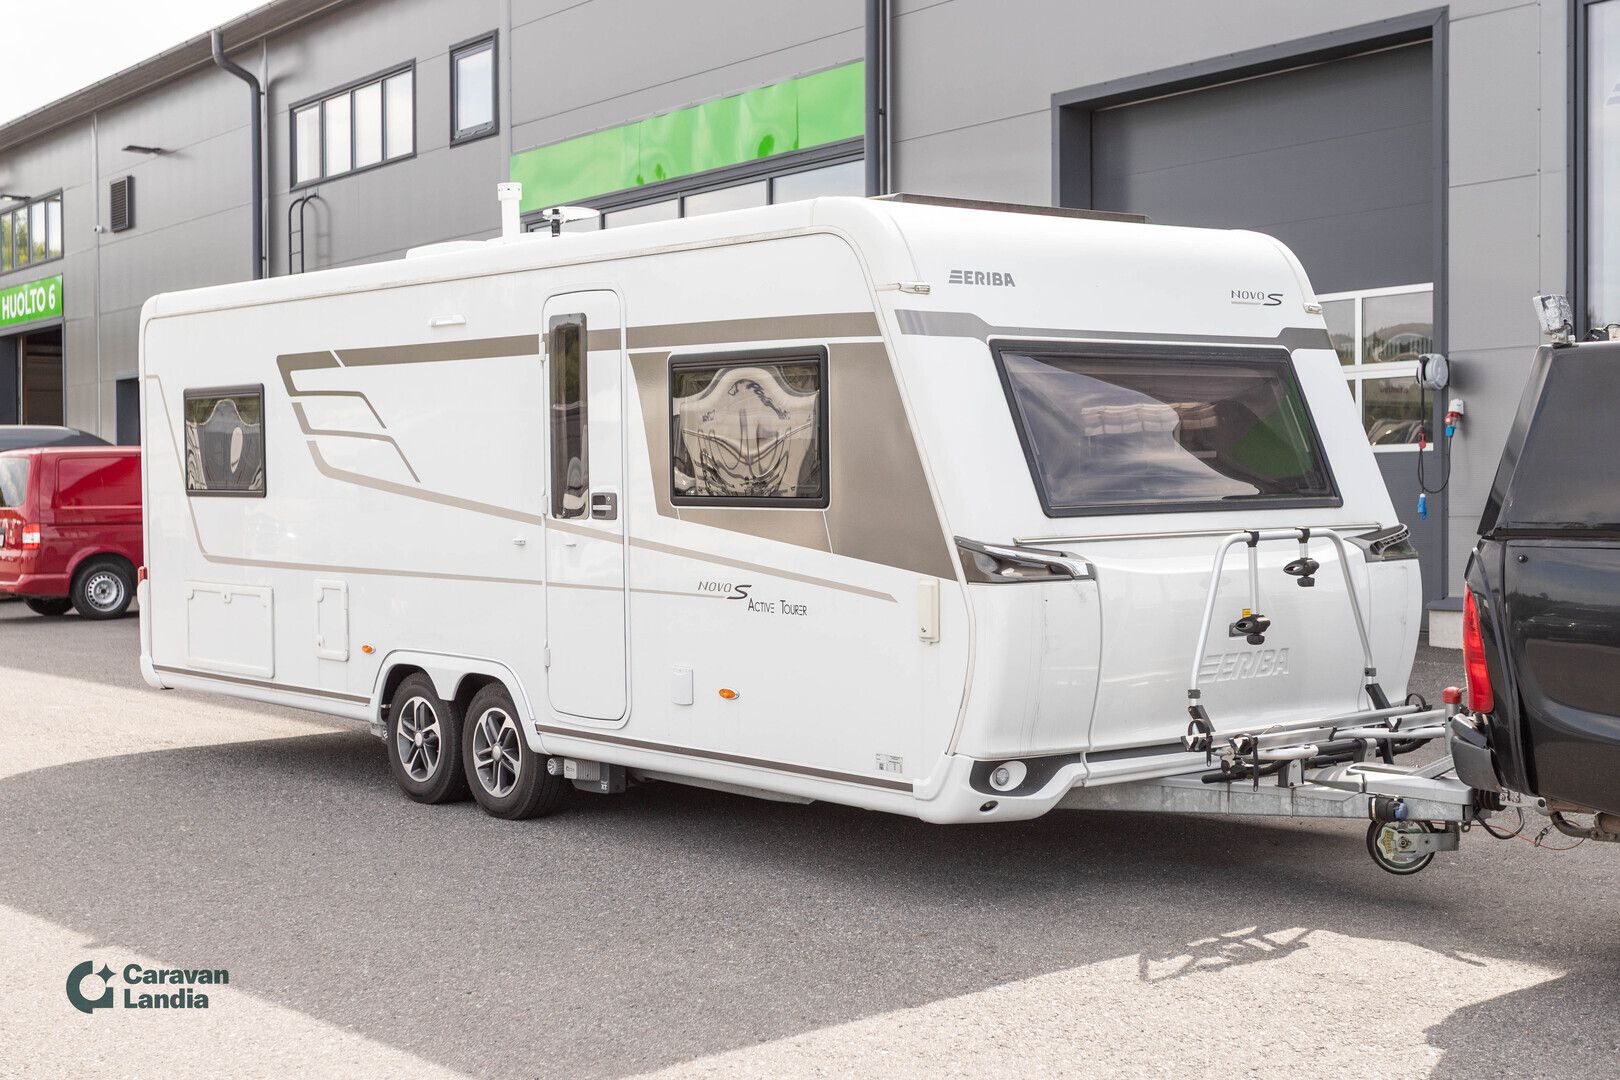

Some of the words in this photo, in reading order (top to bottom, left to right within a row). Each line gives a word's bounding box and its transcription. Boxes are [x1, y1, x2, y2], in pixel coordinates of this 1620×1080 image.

[963, 270, 1016, 287] ERIBA
[1, 286, 46, 320] HUOLTO
[48, 283, 56, 310] 6
[1231, 290, 1265, 300] NOVO
[1262, 293, 1284, 306] S
[697, 581, 732, 593] NOVO
[726, 584, 752, 600] S
